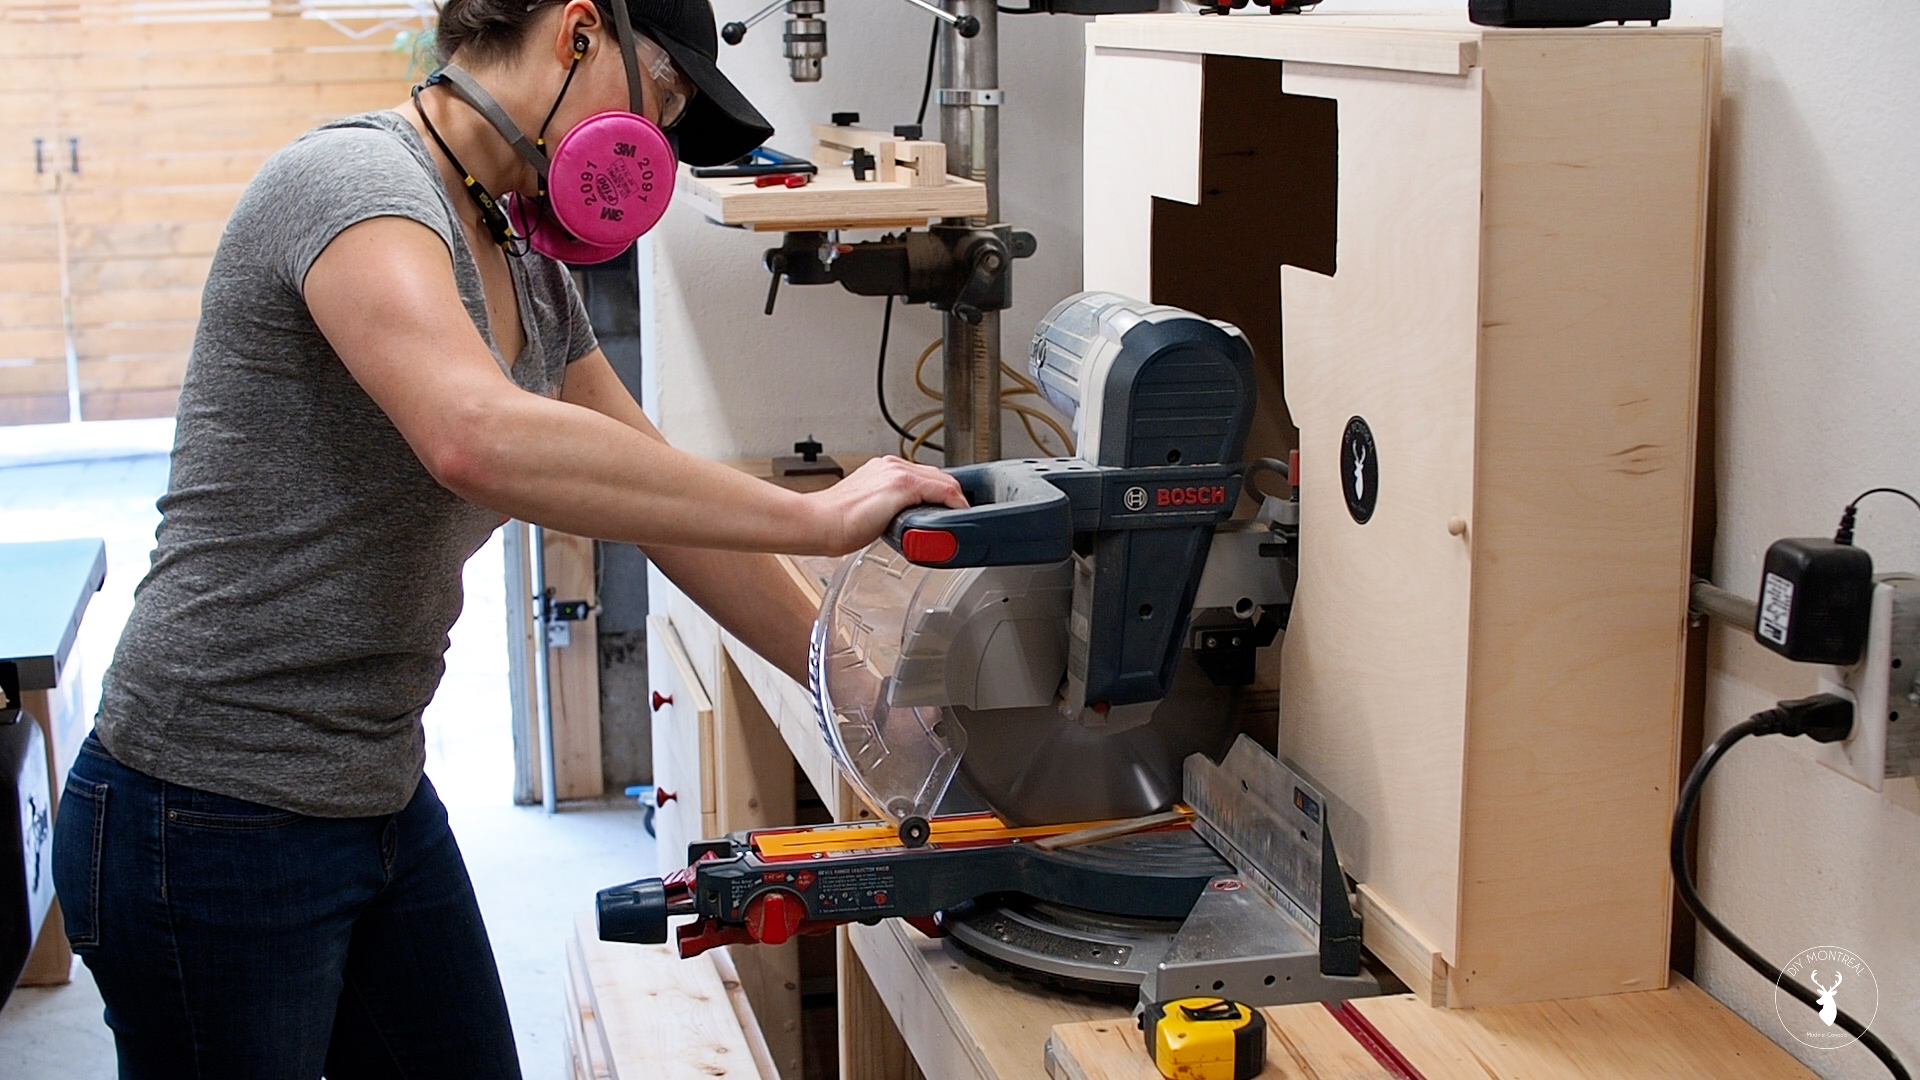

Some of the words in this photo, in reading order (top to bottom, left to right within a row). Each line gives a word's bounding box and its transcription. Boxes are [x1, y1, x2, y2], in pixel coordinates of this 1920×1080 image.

[613, 142, 637, 158] 3M
[599, 177, 618, 202] P100
[600, 206, 624, 222] 3M
[1156, 486, 1226, 507] BOSCH
